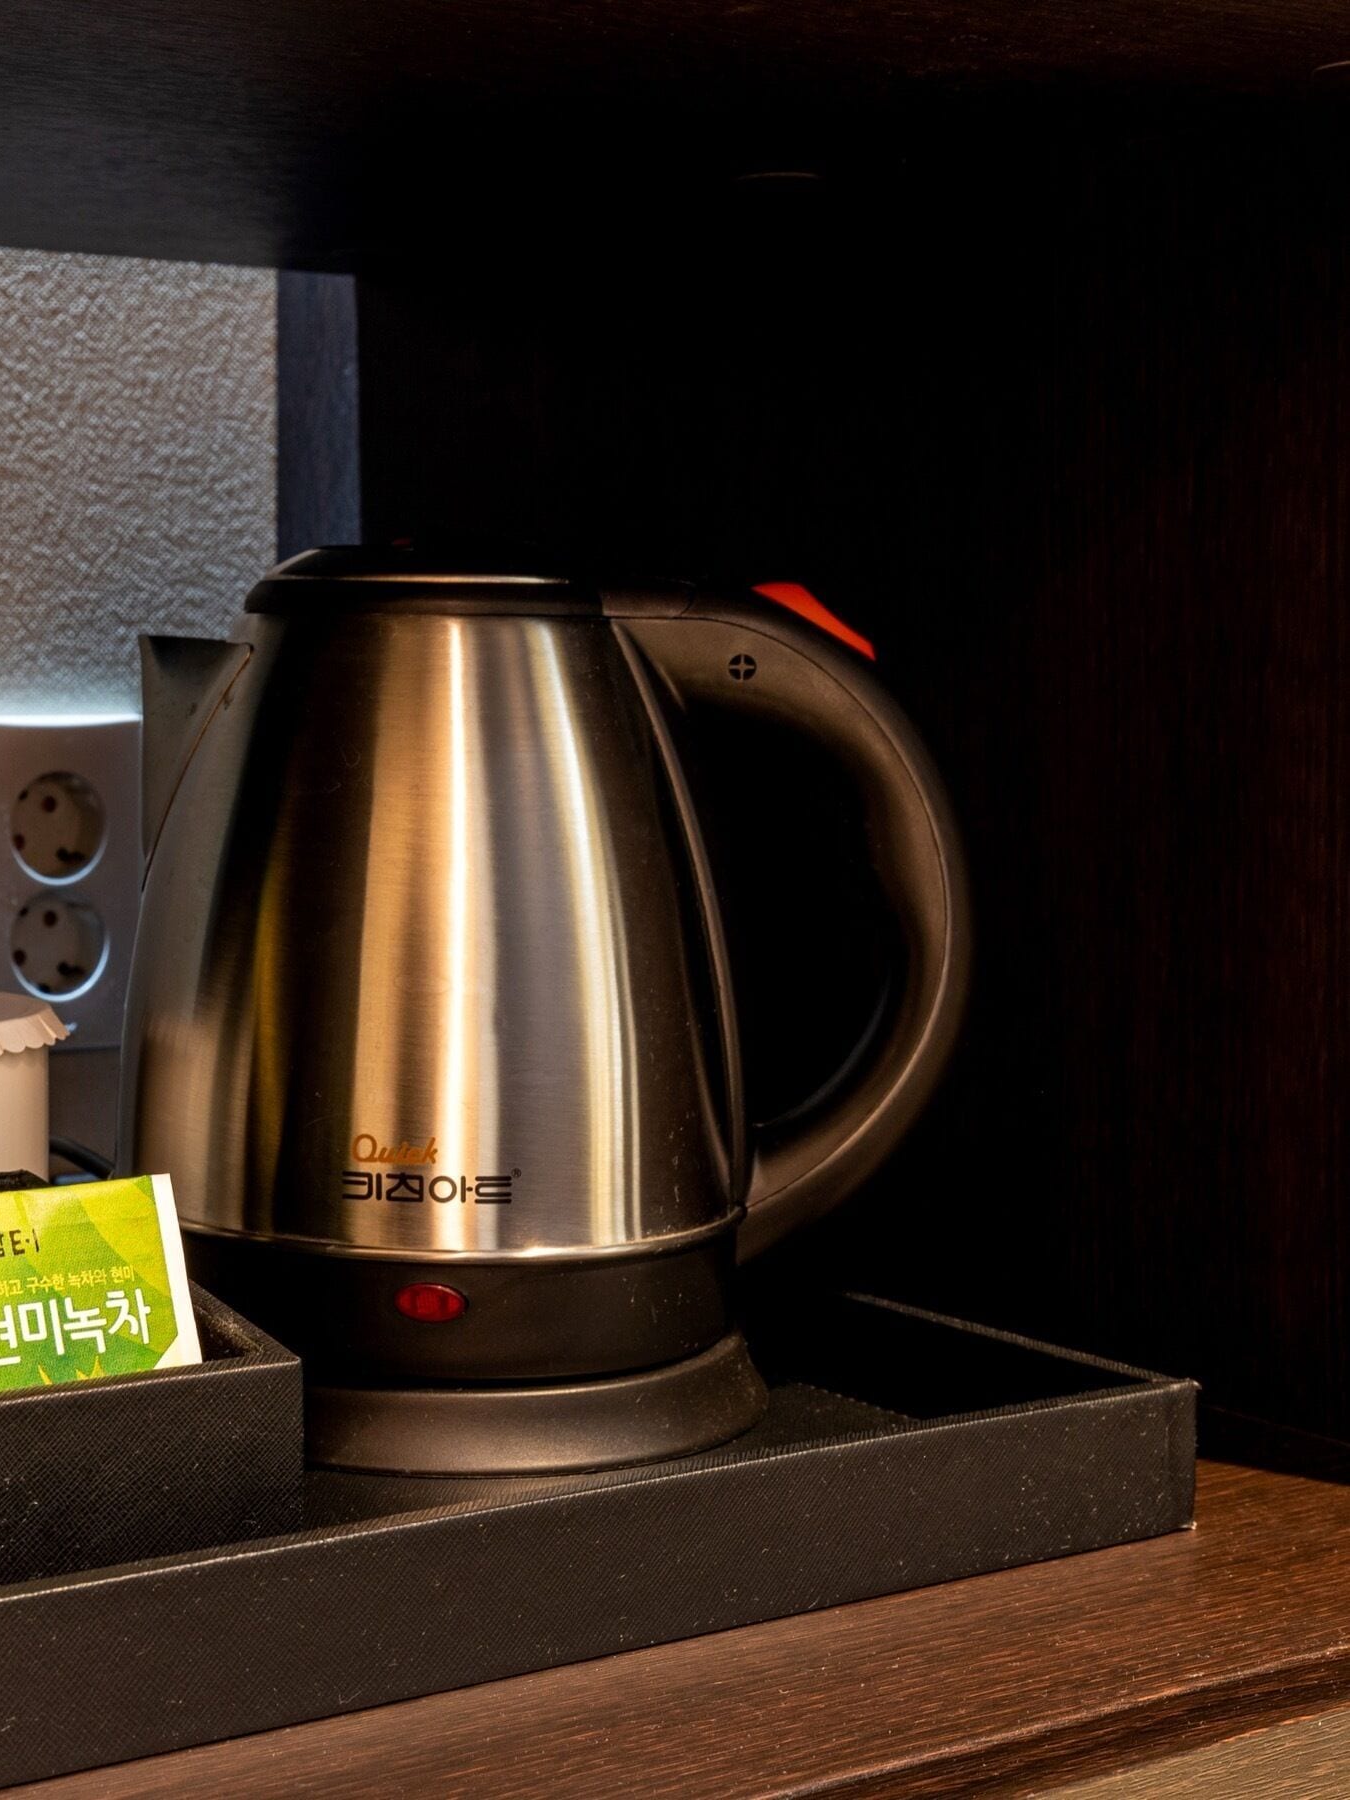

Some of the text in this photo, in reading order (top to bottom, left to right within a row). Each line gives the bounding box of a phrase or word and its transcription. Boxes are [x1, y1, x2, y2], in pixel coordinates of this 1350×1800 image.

[352, 1133, 439, 1165] Quick
[26, 1273, 66, 1294] 구수한
[68, 1268, 108, 1289] 녹차와
[110, 1264, 135, 1284] 현미
